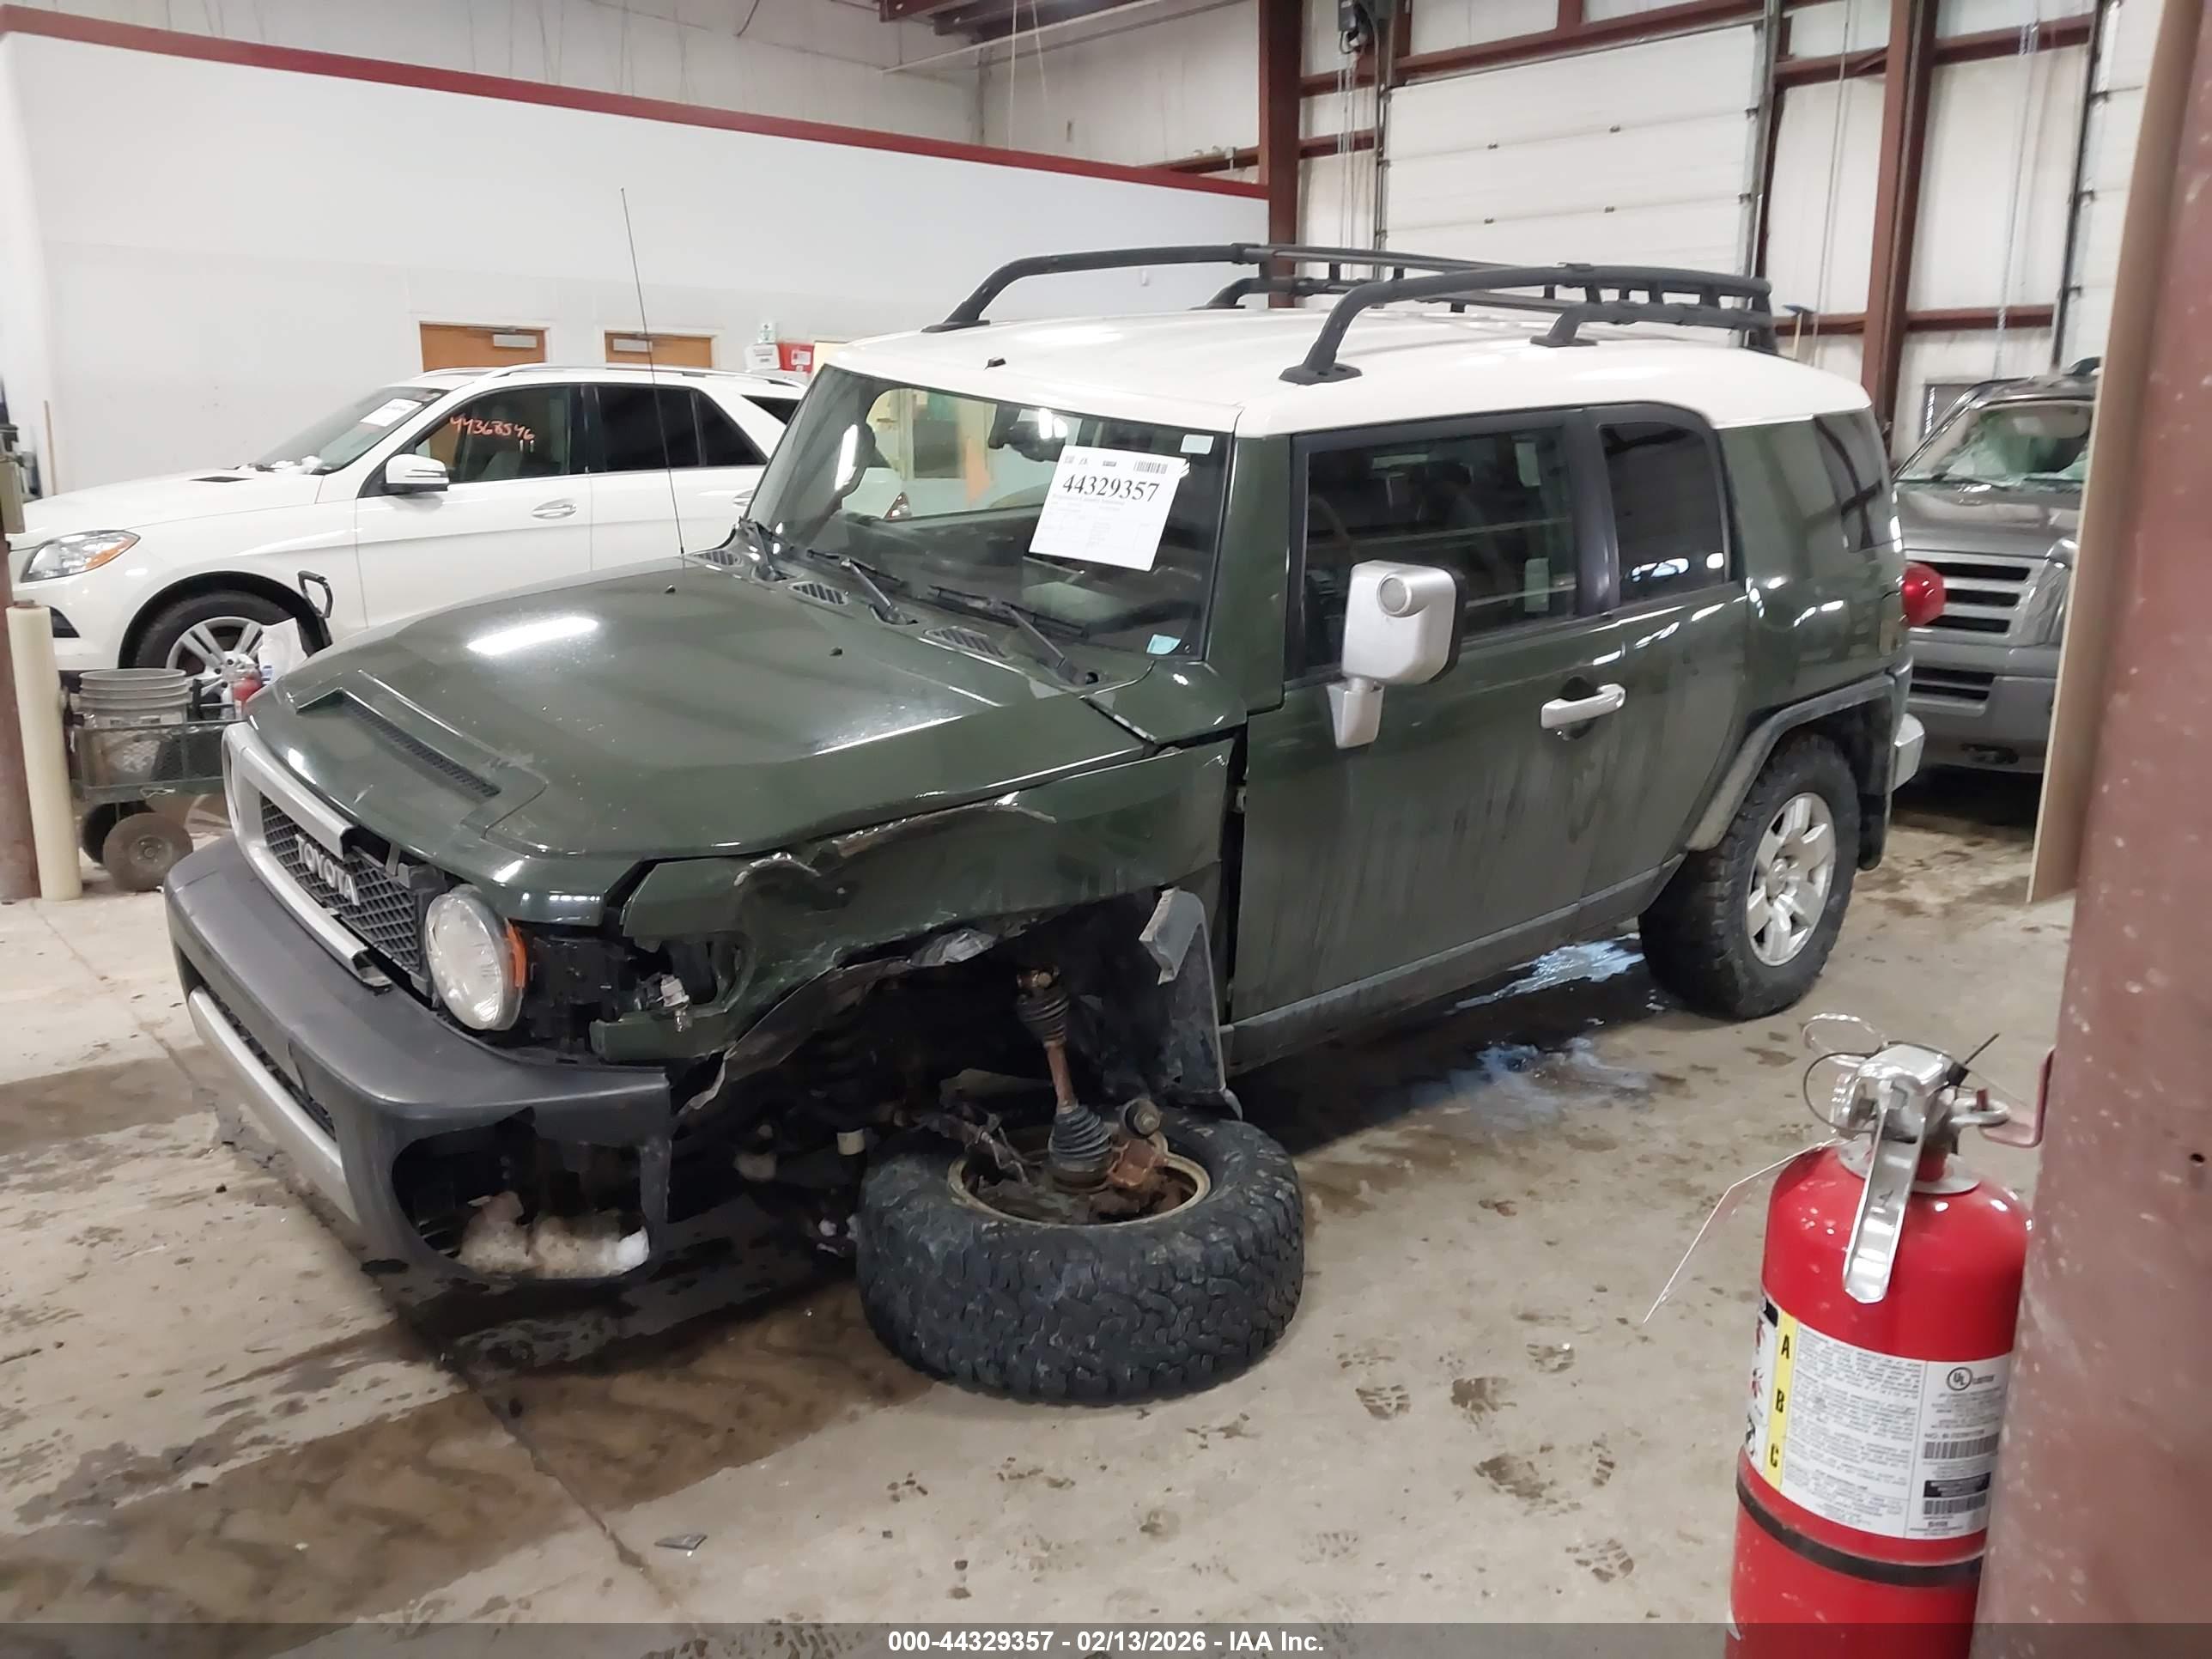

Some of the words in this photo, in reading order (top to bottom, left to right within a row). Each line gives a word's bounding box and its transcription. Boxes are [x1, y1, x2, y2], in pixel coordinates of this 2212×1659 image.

[1062, 474, 1160, 502] 44329357
[295, 833, 361, 906] TOYOTA
[1781, 1334, 1790, 1359] A
[1775, 1389, 1785, 1413] B
[1770, 1443, 1779, 1468] C
